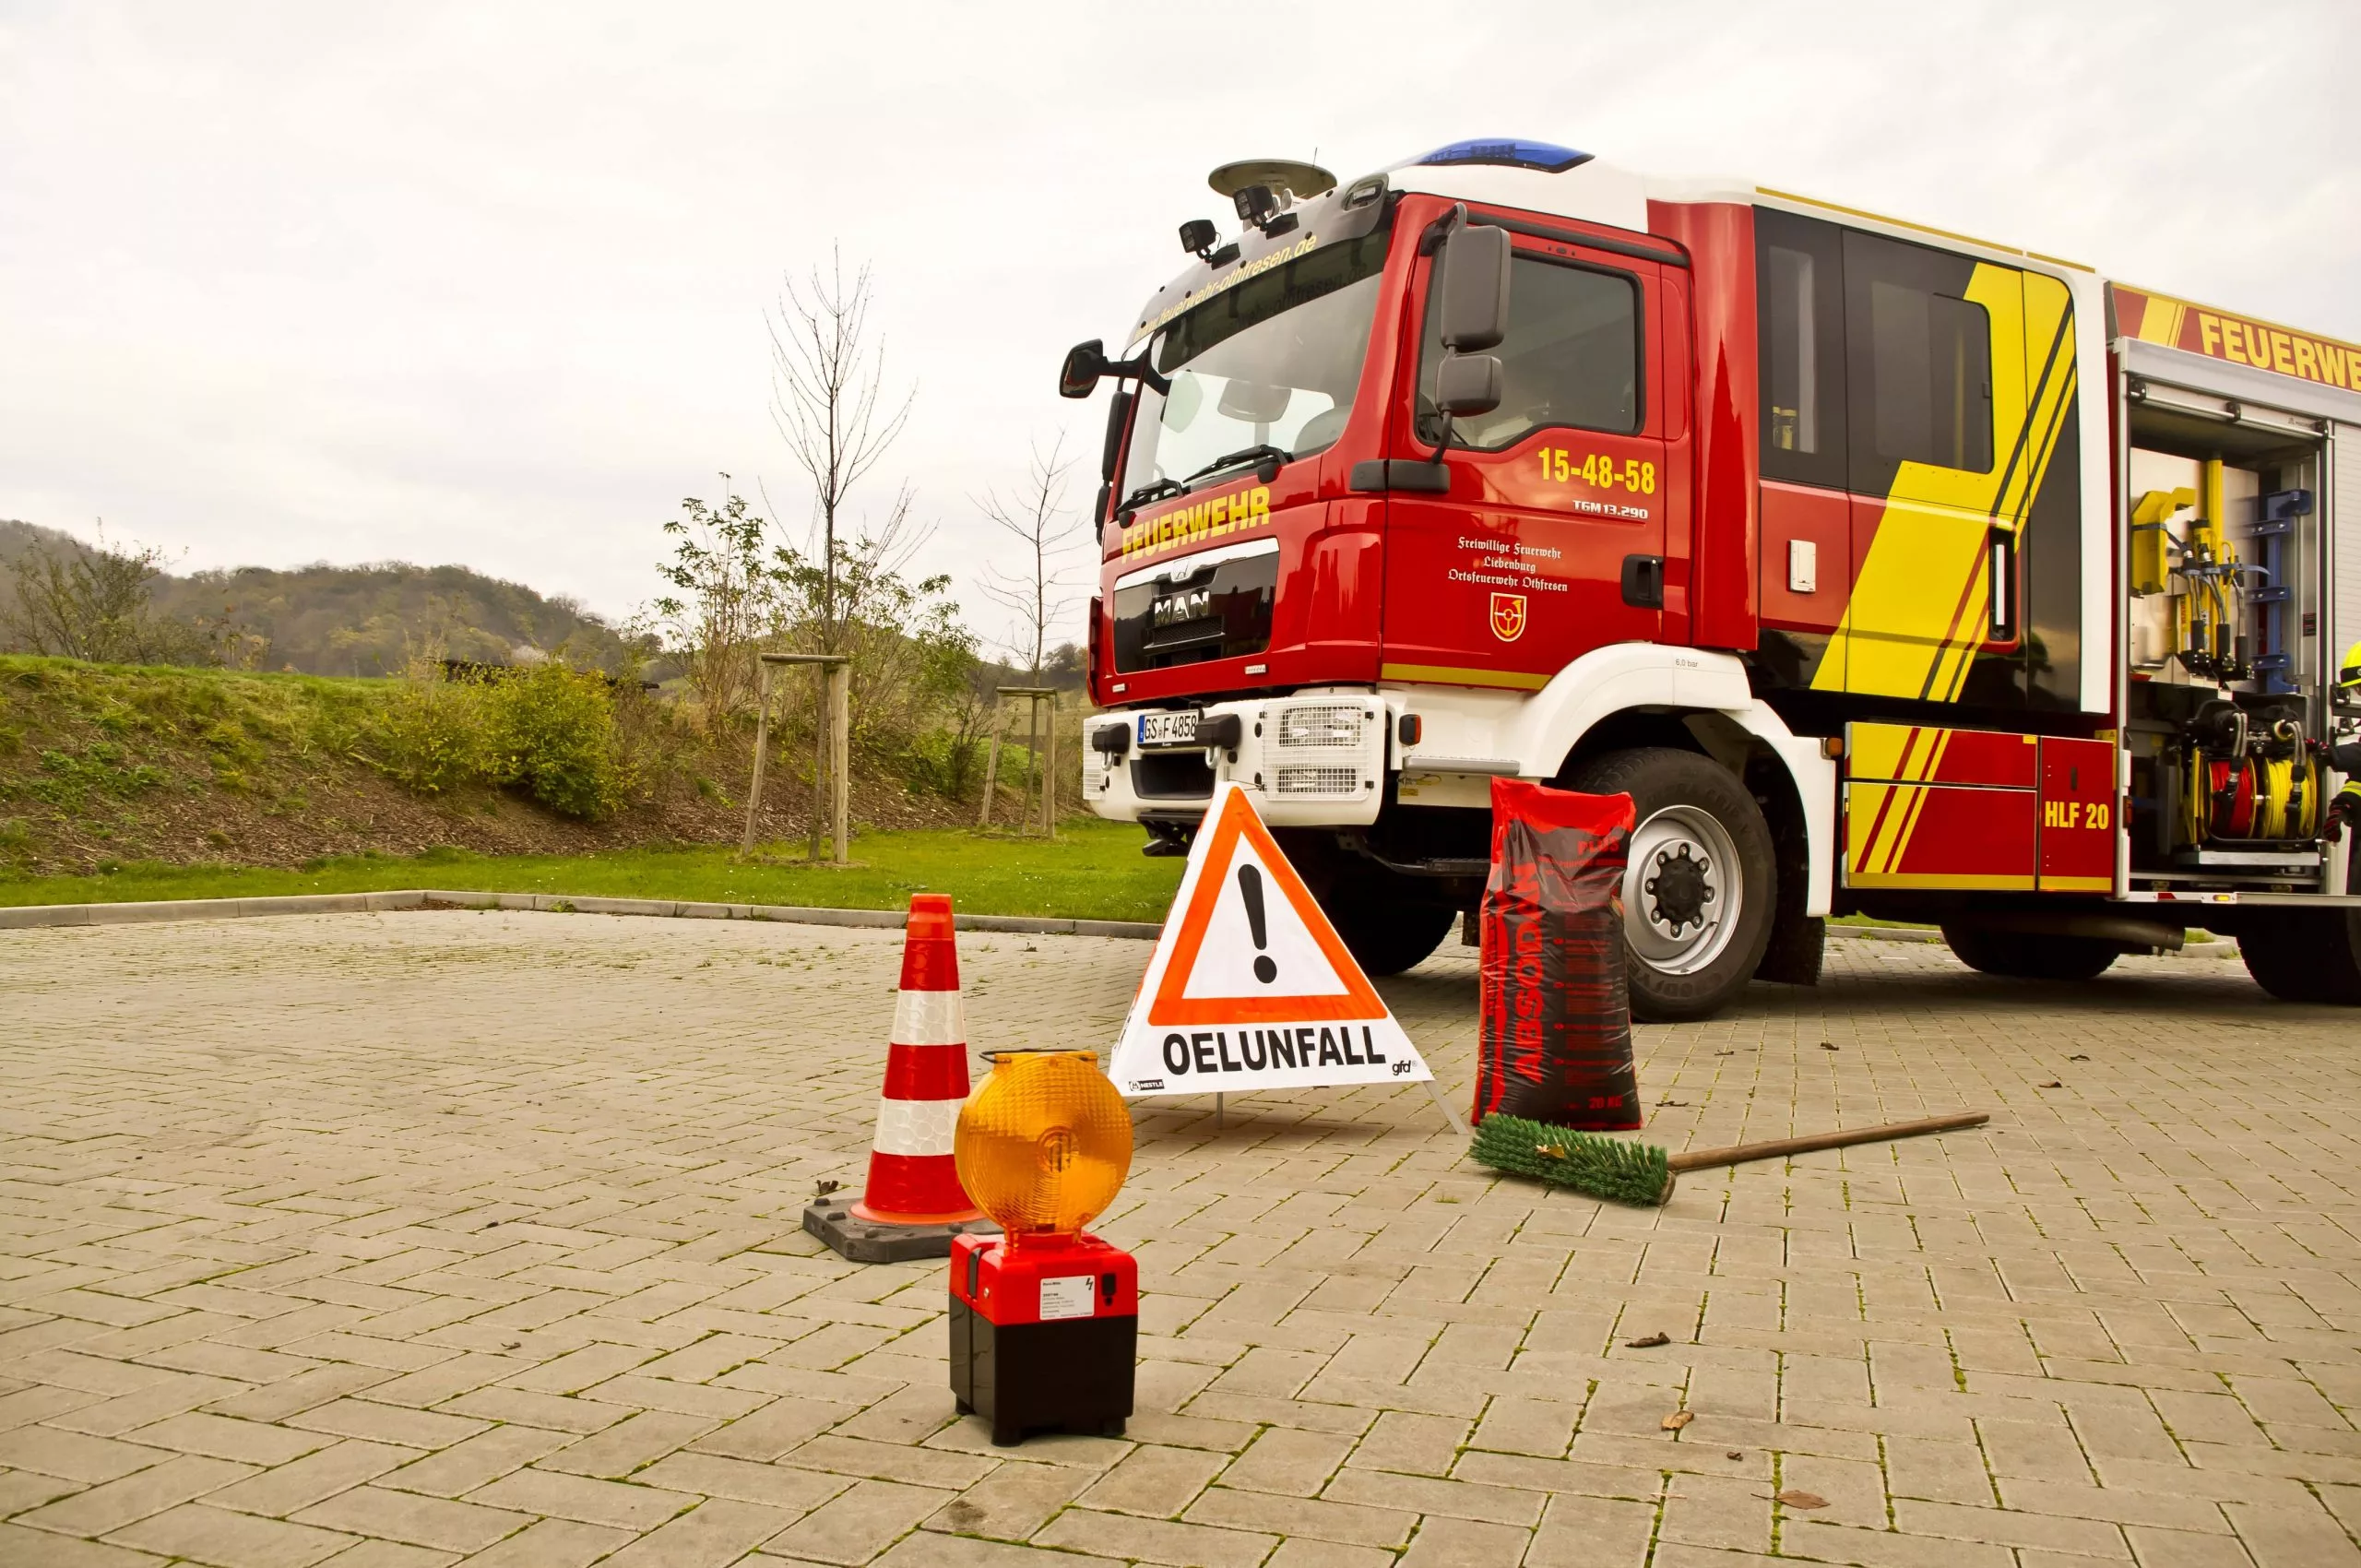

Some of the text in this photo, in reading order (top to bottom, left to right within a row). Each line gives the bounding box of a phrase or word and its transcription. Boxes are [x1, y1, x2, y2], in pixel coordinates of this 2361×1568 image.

[1538, 447, 1655, 494] 15-48-58
[1572, 500, 1649, 519] TGM 13.290
[1121, 486, 1270, 564] FEUERWEHR
[1457, 537, 1561, 559] Freiwillige Feuerwehr
[1483, 556, 1536, 574] Liebenburg
[1447, 569, 1568, 592] Ortsfeuerwehr Othfresen
[1155, 591, 1209, 627] MAN
[1145, 715, 1197, 740] GS F 4858
[2045, 801, 2109, 830] HLF 20
[1577, 837, 1619, 855] PLUS
[1163, 1026, 1386, 1075] OELUNFALL
